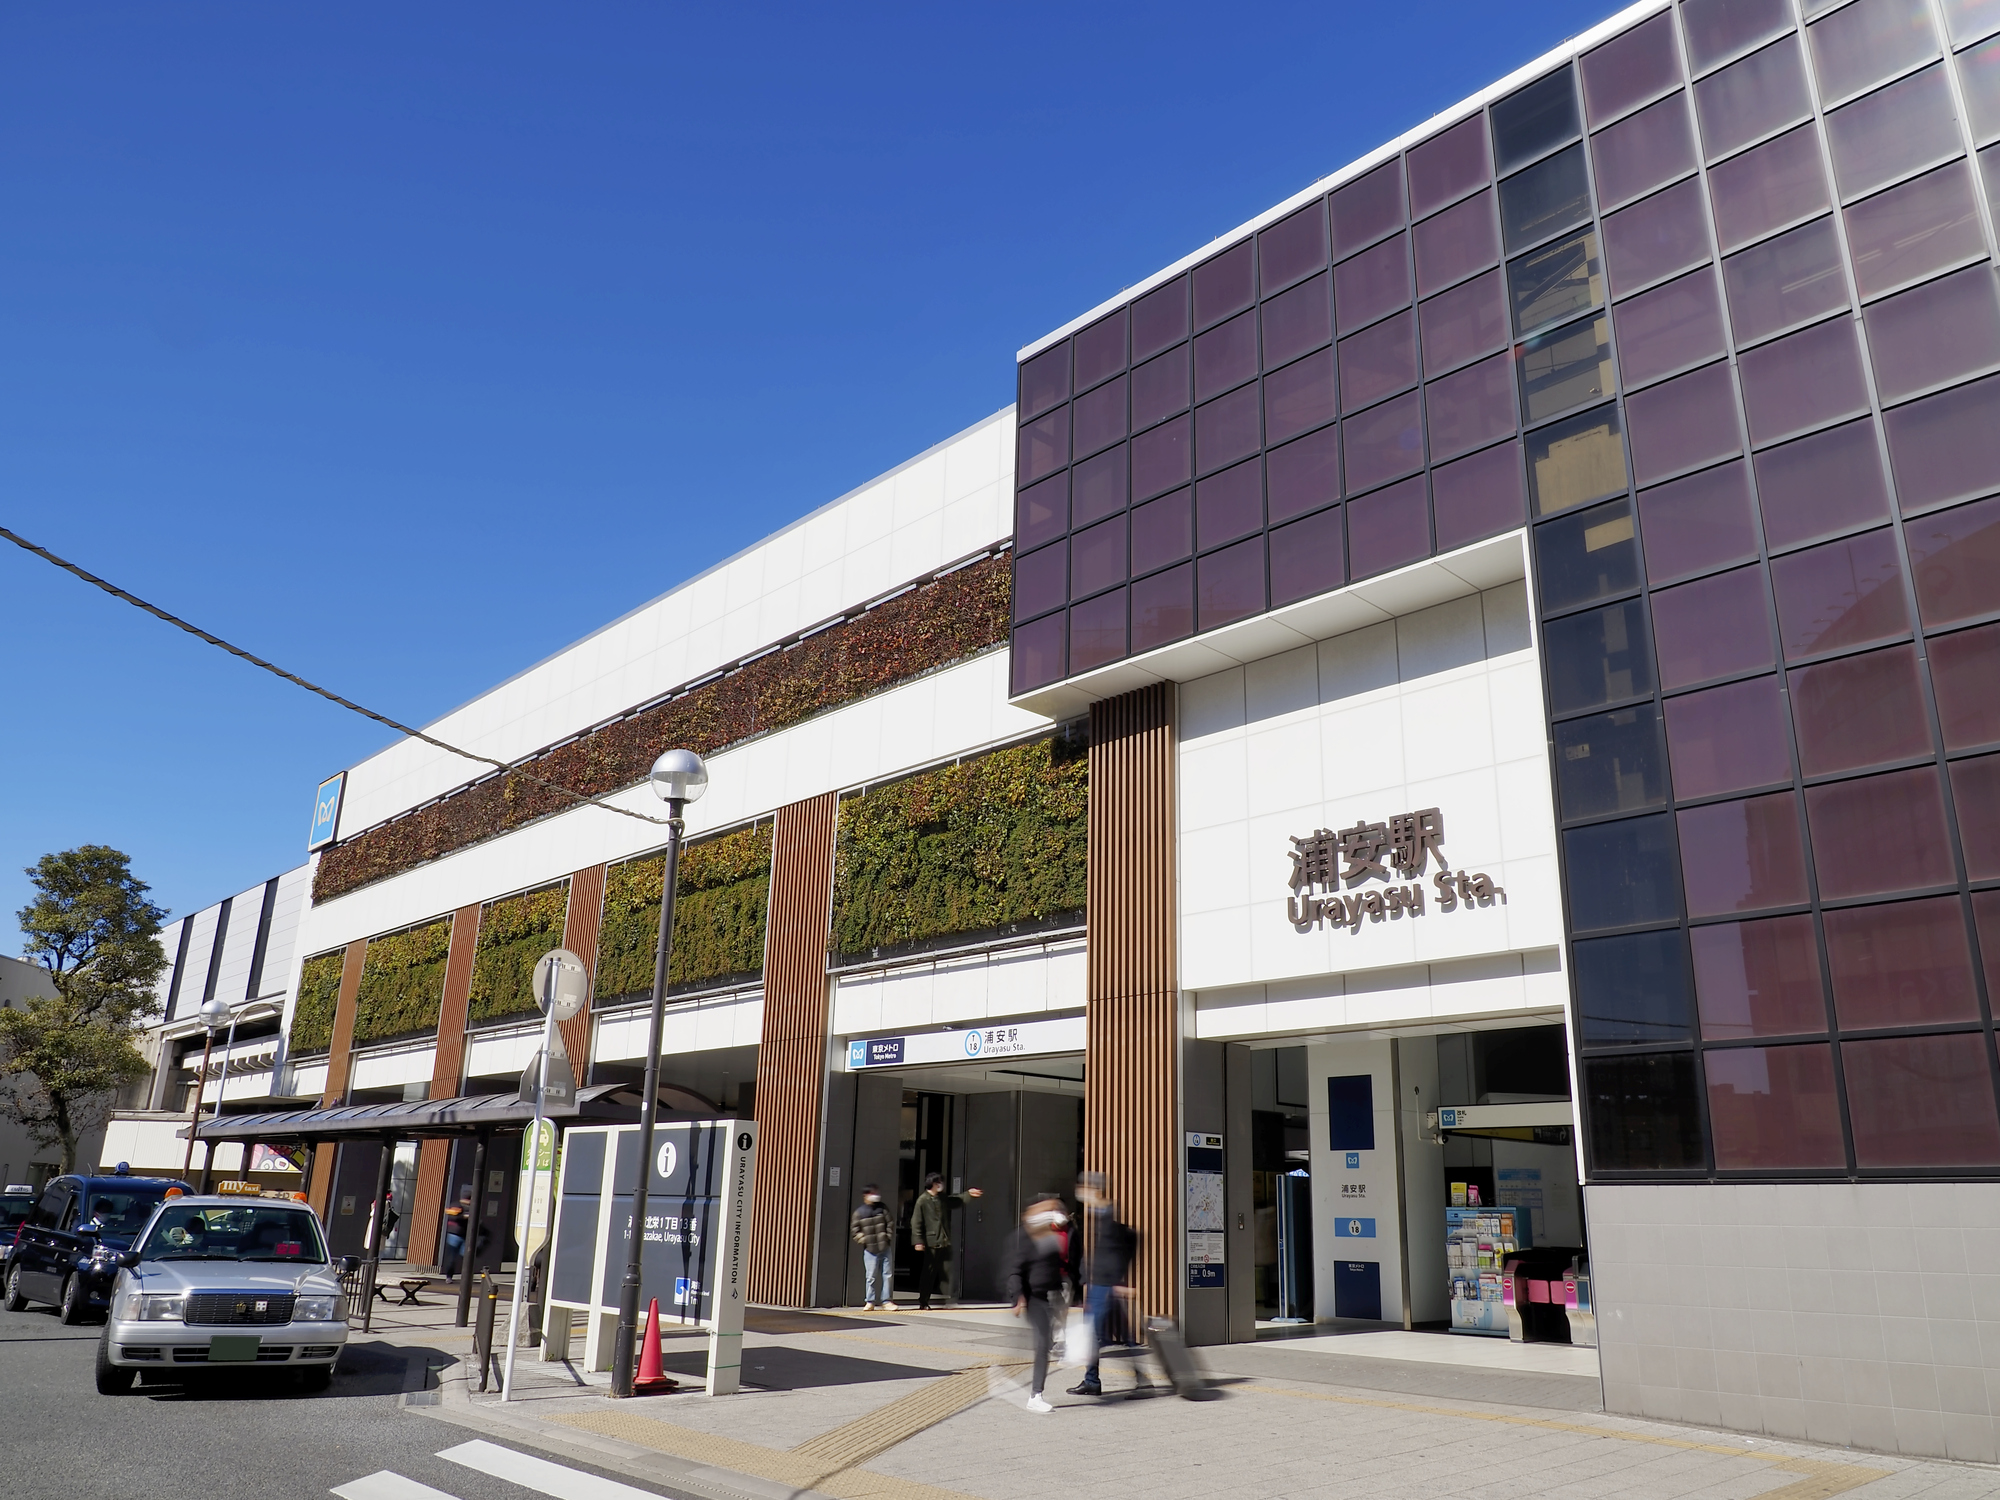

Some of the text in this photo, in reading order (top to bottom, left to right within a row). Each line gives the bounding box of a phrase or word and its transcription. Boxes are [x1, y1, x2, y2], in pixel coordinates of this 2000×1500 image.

[1287, 807, 1446, 893] 浦安駅
[1287, 871, 1507, 932] Urayasu Sta.
[984, 1028, 1018, 1044] 浦安駅
[872, 1043, 899, 1054] 東京メトロ
[969, 1042, 978, 1051] 18
[984, 1043, 1026, 1055] Urayasu Sta.
[737, 1156, 746, 1197] URAYASU
[223, 1180, 246, 1193] my
[1341, 1184, 1366, 1193] 浦安駅
[1351, 1226, 1360, 1234] 18
[731, 1221, 741, 1284] INFORMATION
